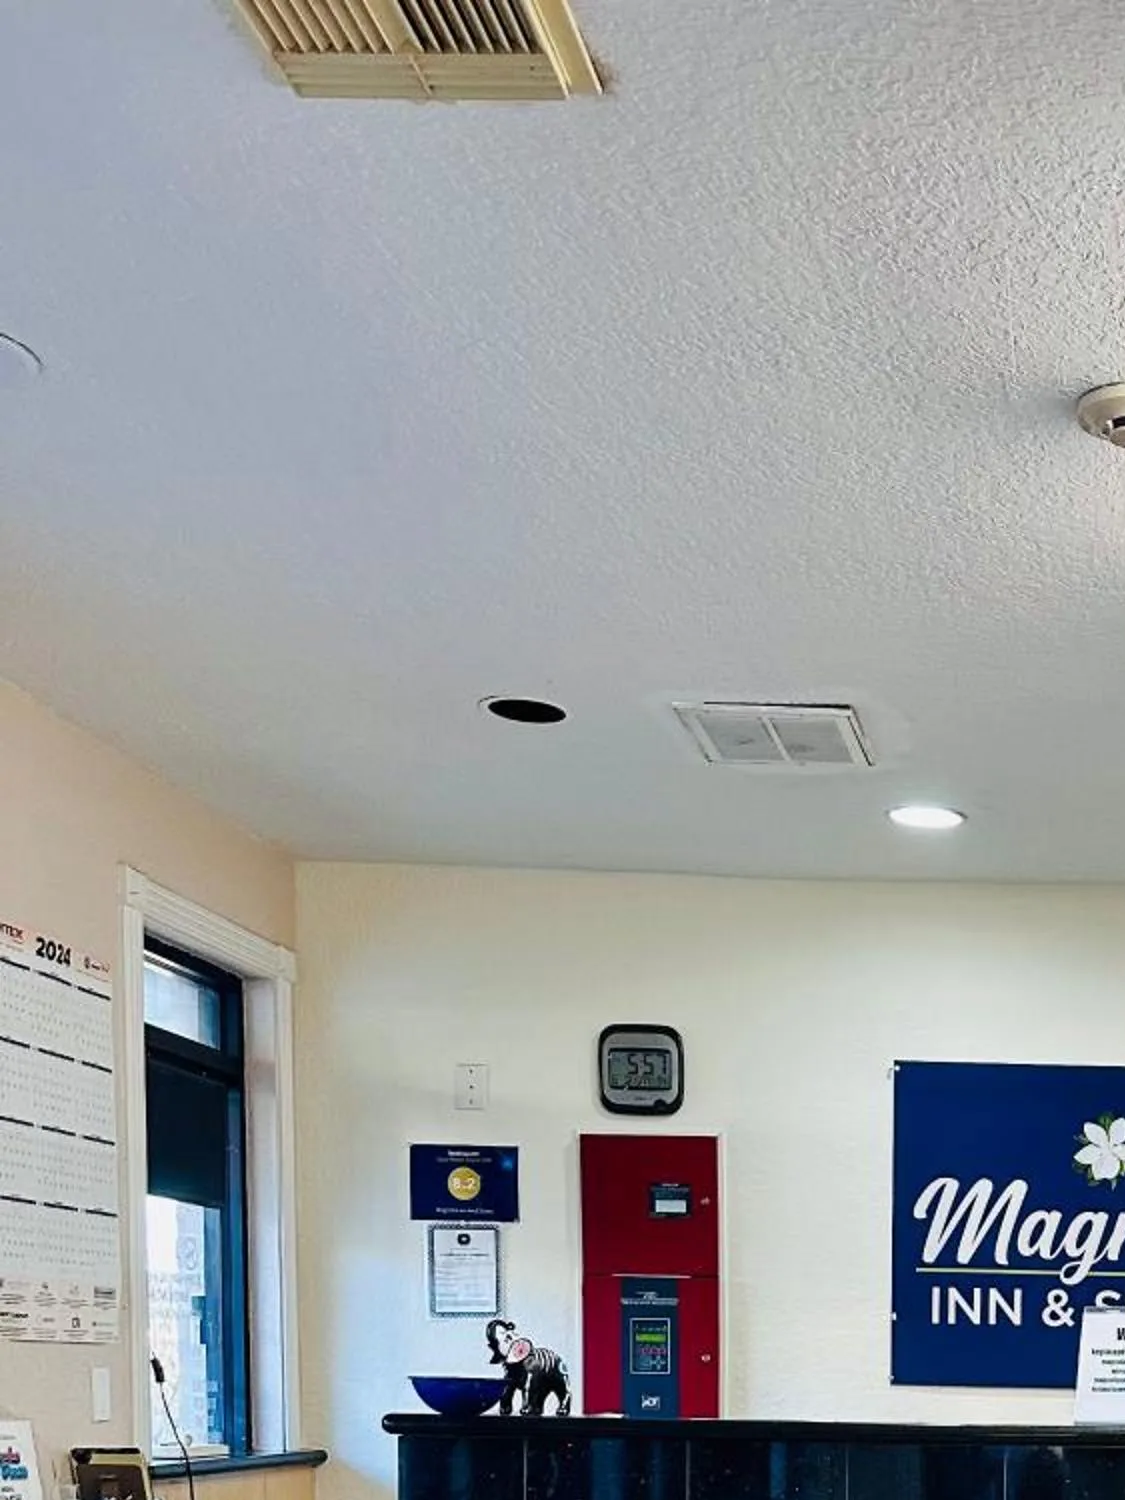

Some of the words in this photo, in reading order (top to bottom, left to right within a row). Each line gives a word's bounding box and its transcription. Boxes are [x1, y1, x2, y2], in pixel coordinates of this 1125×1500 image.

[35, 936, 71, 967] 2024
[930, 1286, 1023, 1327] INN
[1041, 1288, 1076, 1328] &
